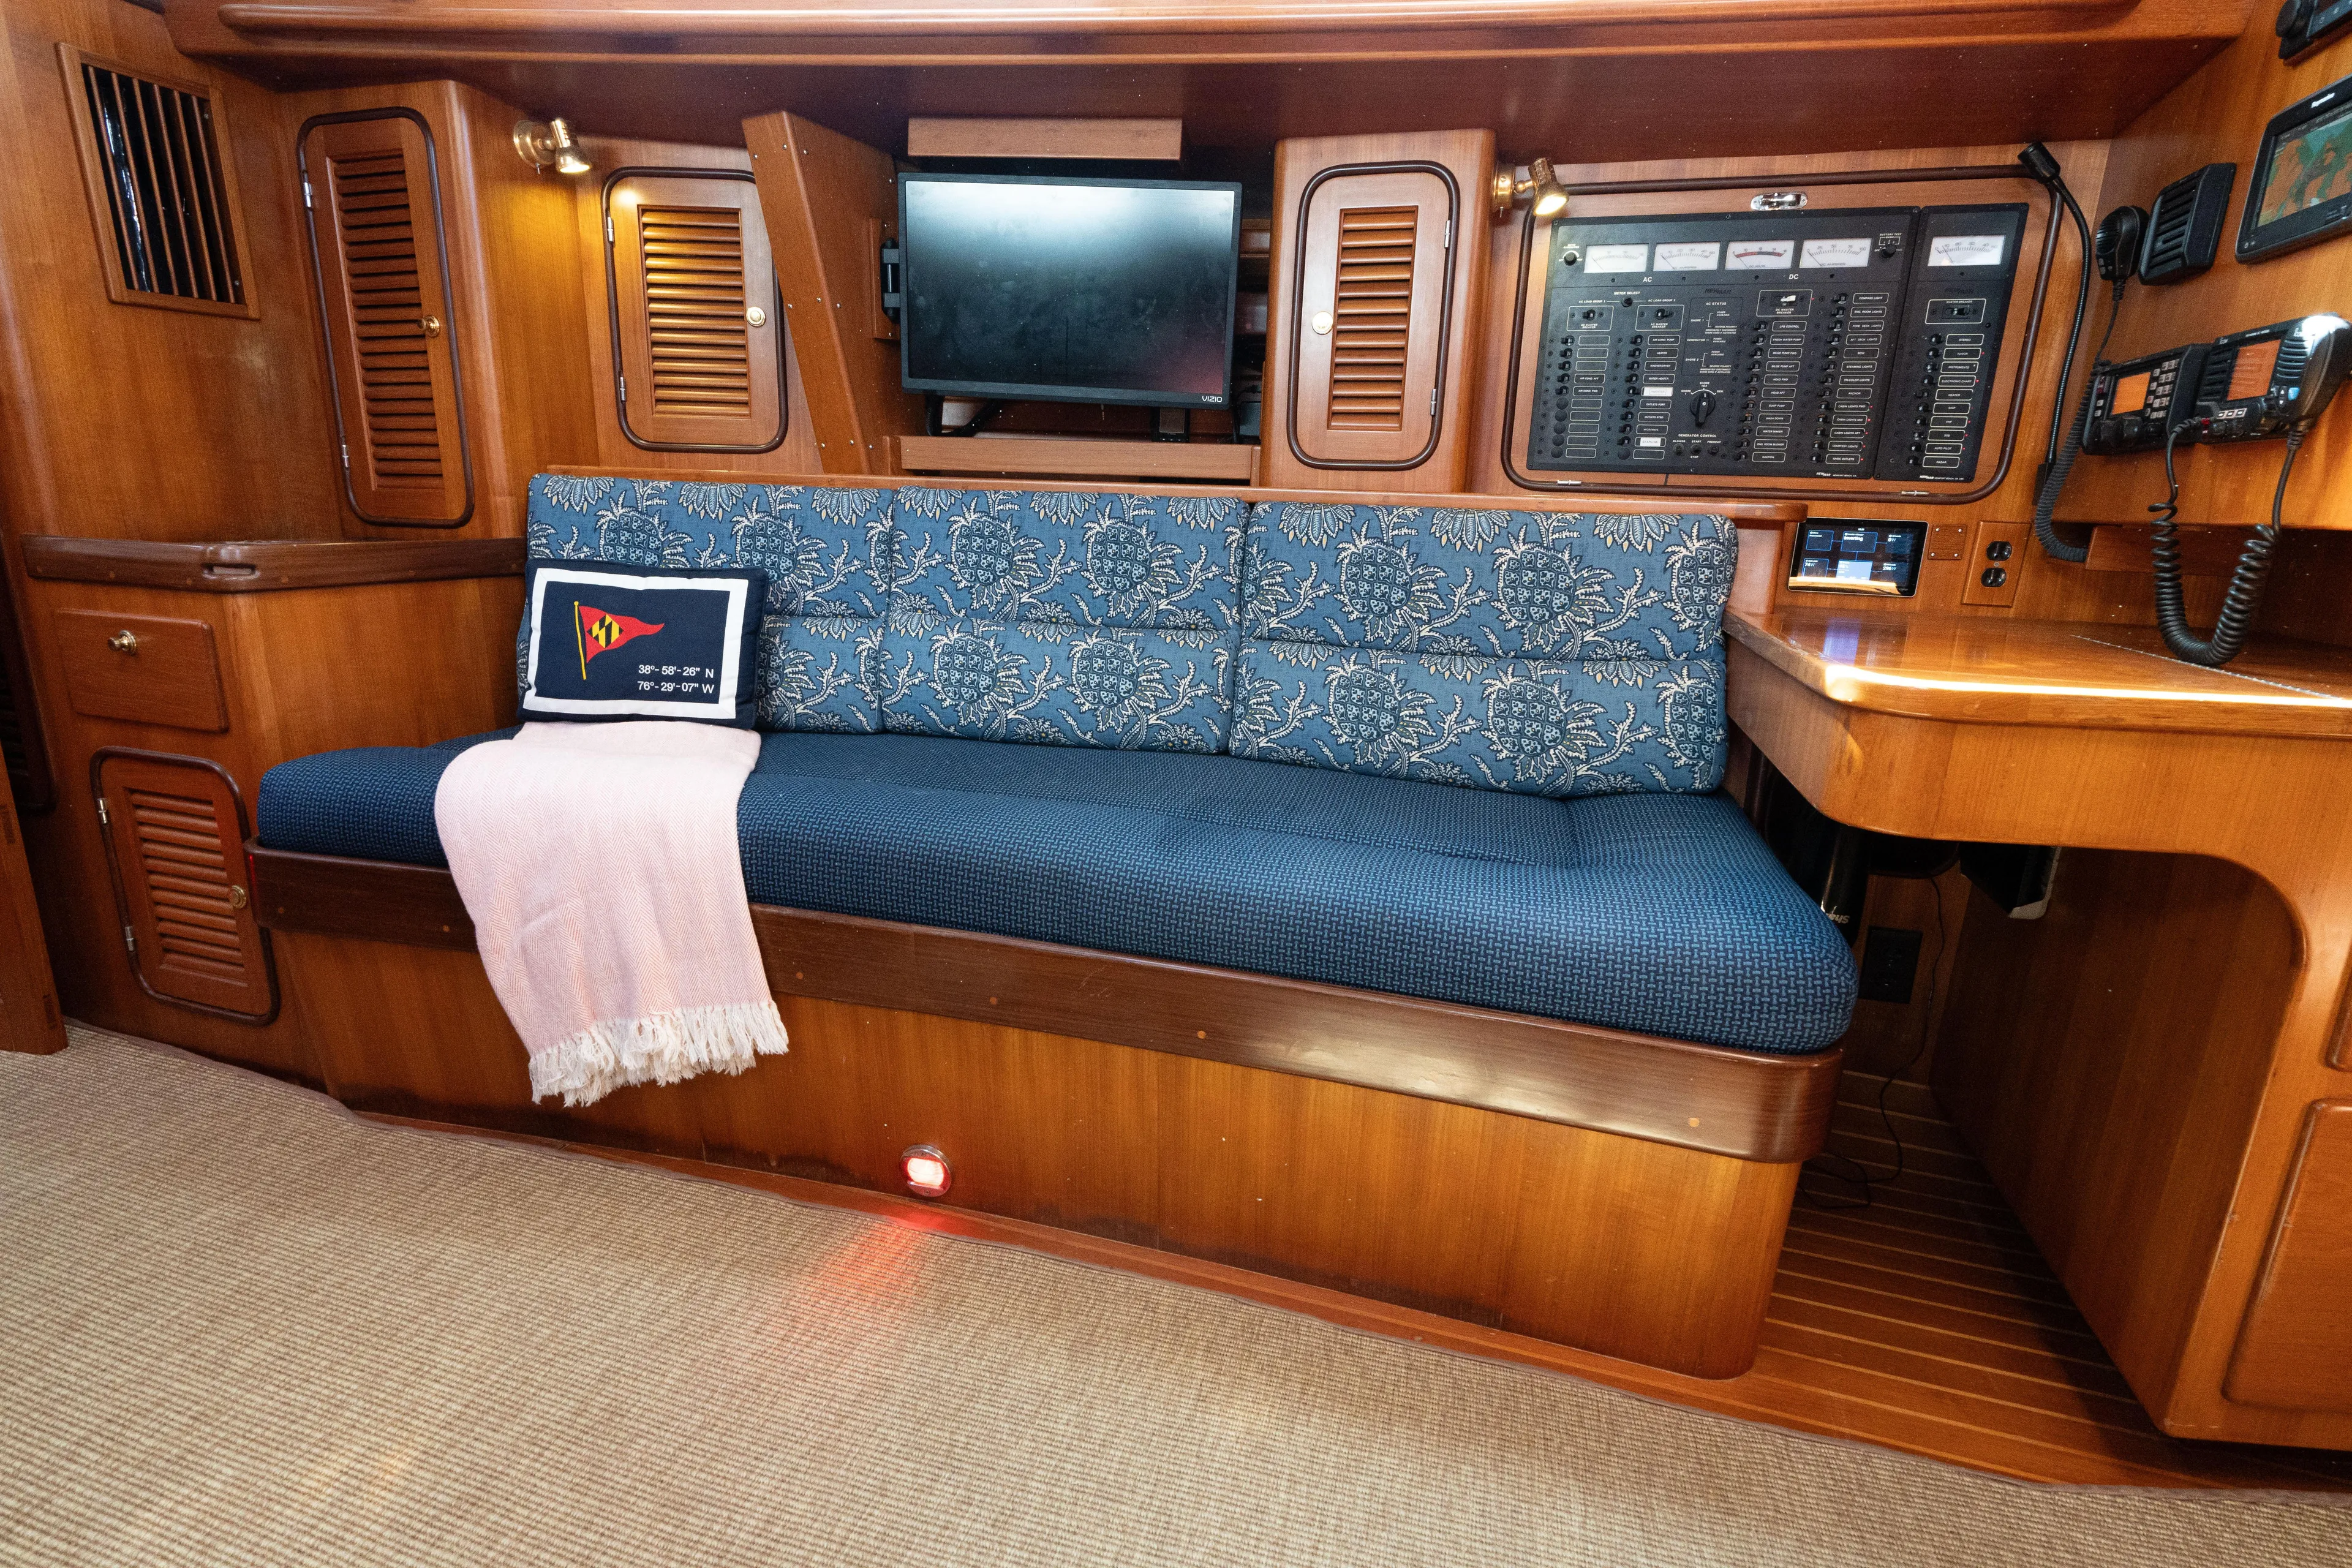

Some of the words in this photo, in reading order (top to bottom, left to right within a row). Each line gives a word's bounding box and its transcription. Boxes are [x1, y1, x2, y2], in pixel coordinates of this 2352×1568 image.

[705, 668, 714, 678] N
[702, 684, 714, 694] W
[1828, 913, 1850, 924] Sha
